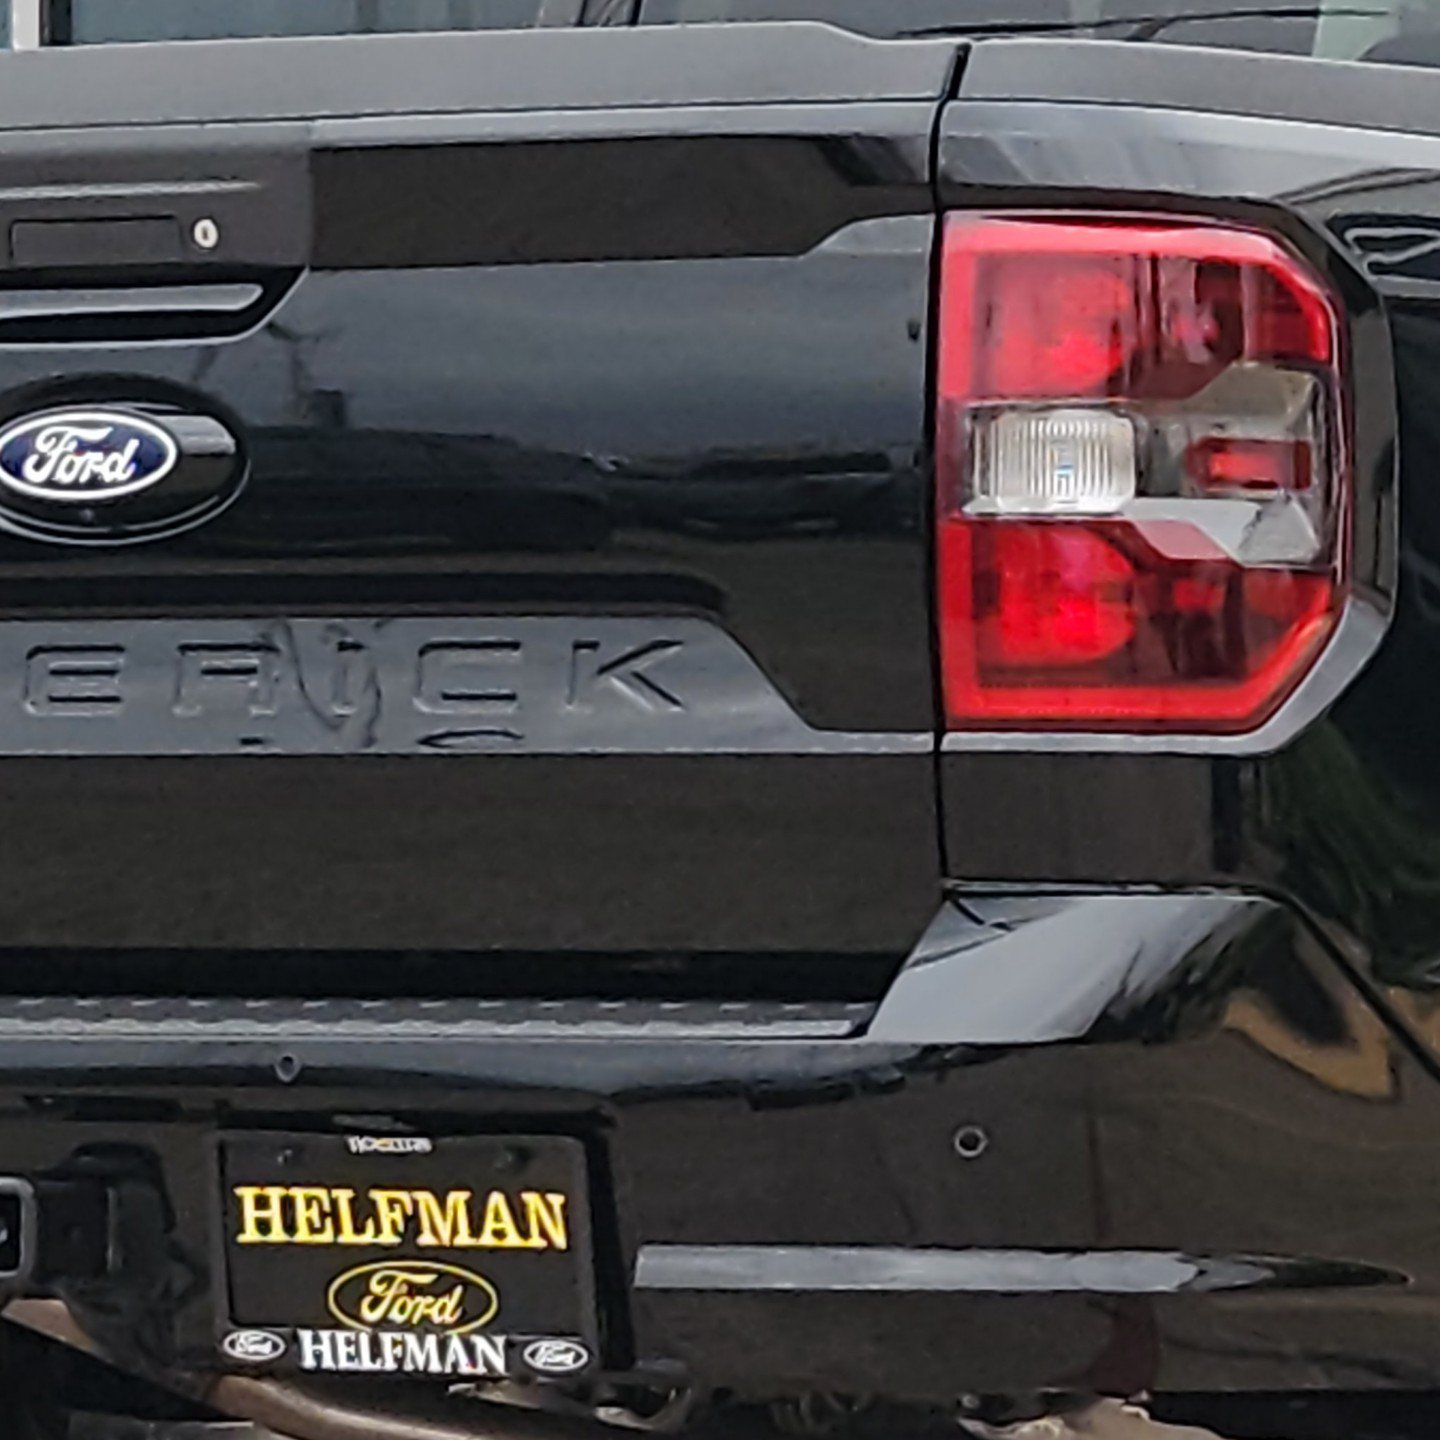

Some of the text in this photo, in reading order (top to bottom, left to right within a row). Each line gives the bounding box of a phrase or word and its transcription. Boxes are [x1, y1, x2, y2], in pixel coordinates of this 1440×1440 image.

[22, 425, 141, 484] Ford
[232, 1184, 568, 1250] HELFMAN
[359, 1268, 465, 1326] Ford
[296, 1328, 510, 1376] HELFMAN
